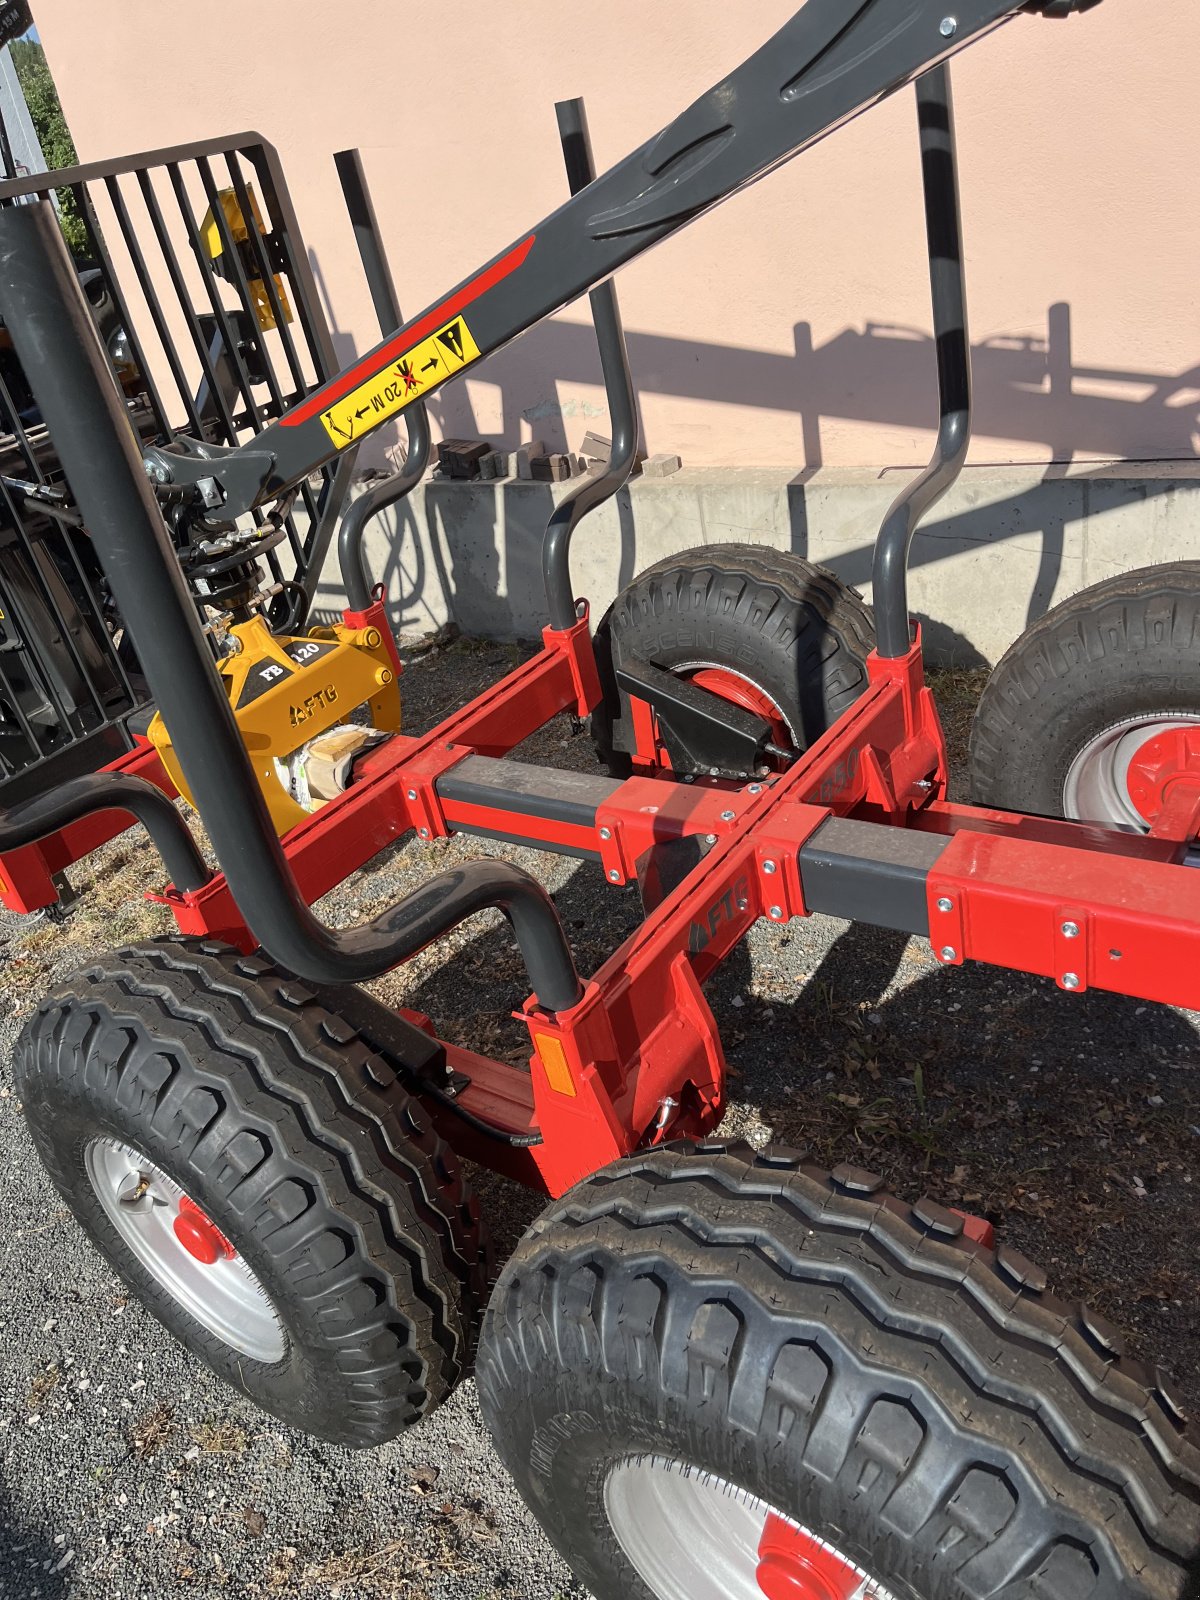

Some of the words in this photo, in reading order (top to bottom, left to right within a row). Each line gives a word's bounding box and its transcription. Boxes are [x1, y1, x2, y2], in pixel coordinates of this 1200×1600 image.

[384, 382, 402, 402] 20
[370, 394, 385, 413] M
[259, 664, 284, 682] FB
[291, 643, 320, 663] 120
